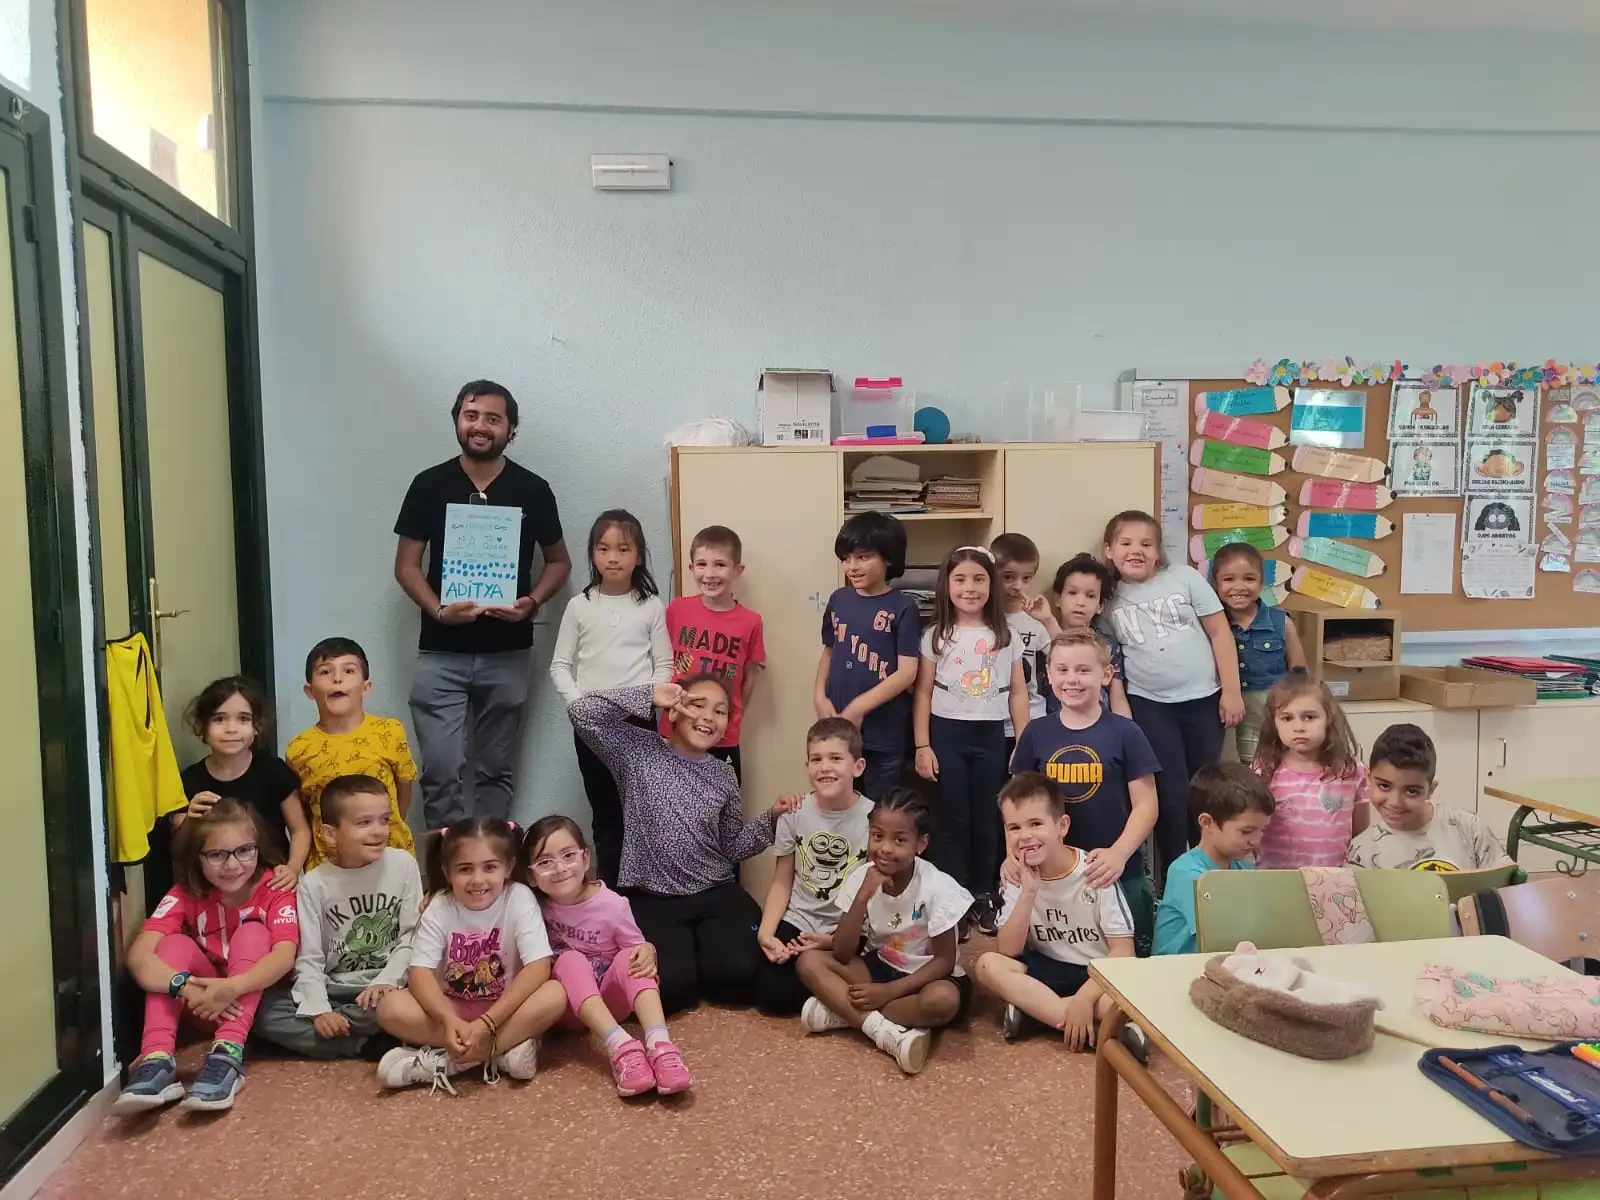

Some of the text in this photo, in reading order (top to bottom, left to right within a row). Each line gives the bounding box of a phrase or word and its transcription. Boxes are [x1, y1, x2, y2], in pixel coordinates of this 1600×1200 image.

[679, 625, 741, 658] MADE
[850, 634, 889, 680] YORK
[1046, 762, 1103, 784] PUMA
